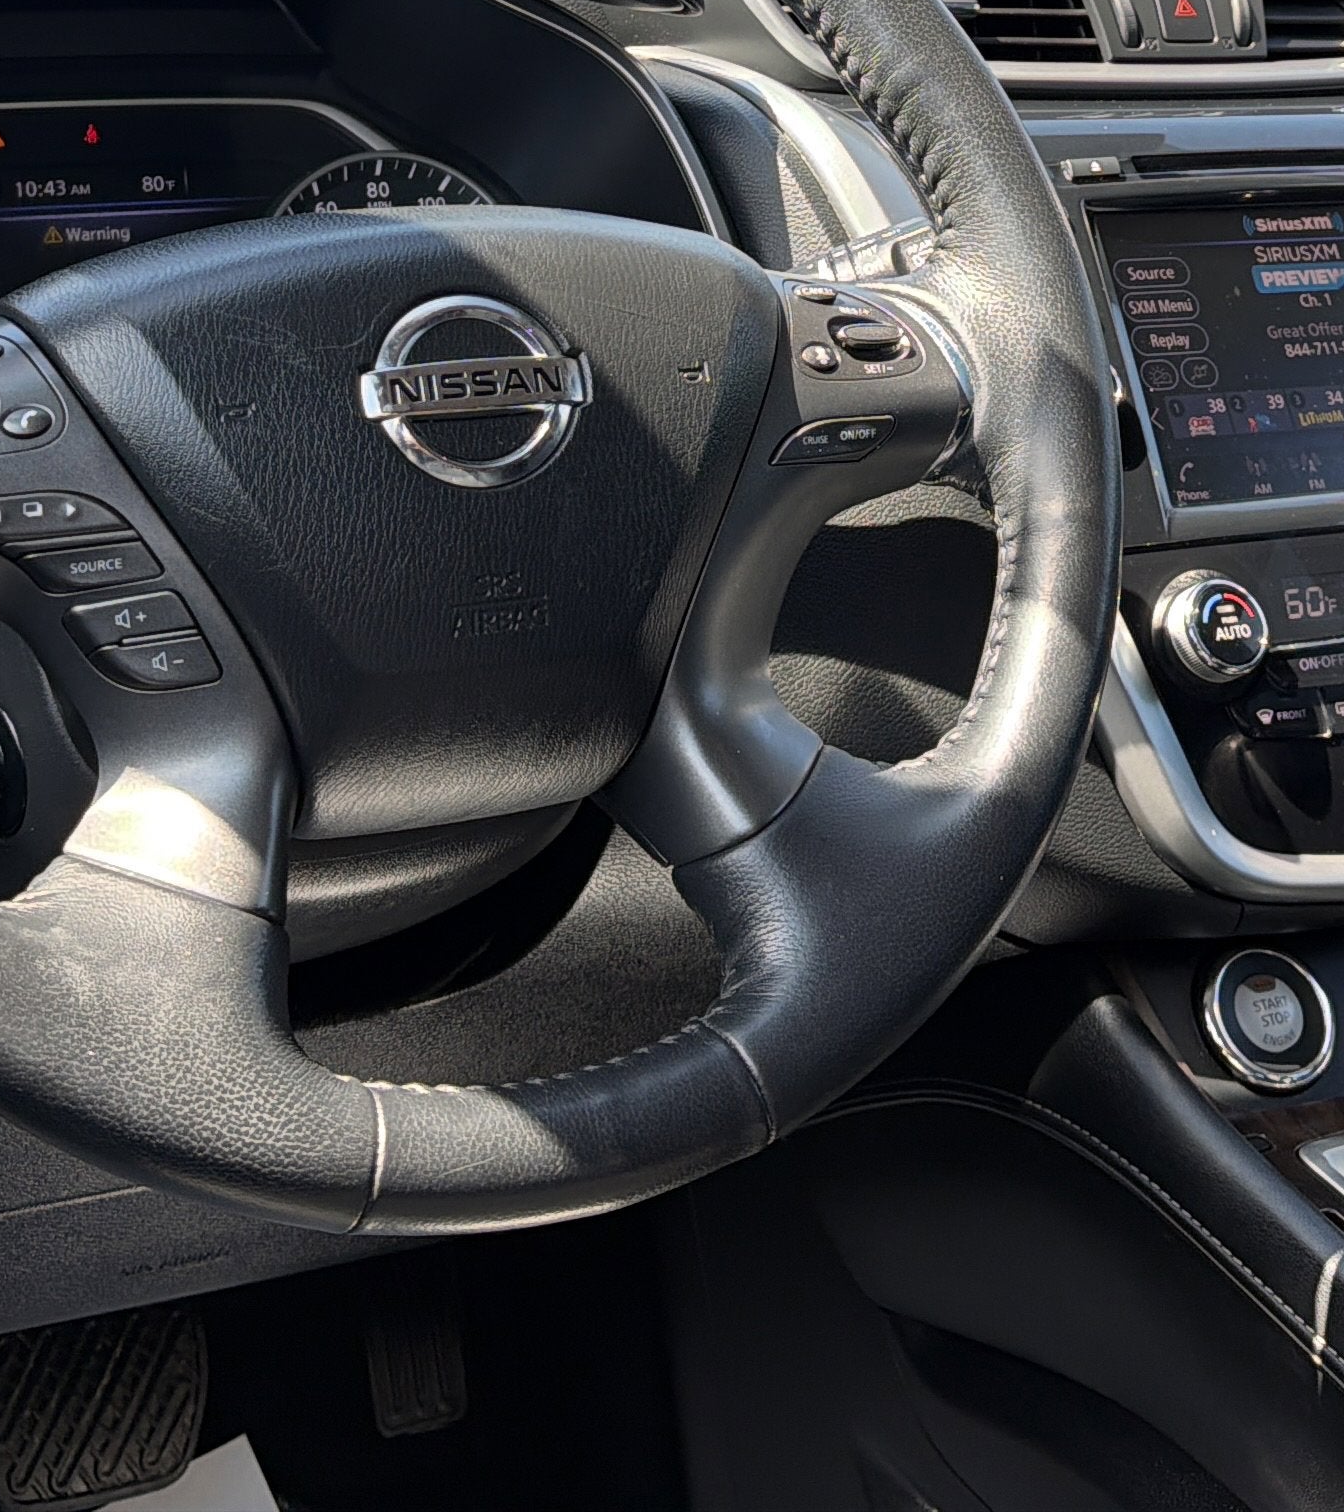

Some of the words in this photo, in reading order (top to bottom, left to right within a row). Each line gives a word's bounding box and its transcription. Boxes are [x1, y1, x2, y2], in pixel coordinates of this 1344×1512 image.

[15, 180, 67, 198] 10:43
[70, 184, 91, 196] AM
[367, 181, 390, 198] 80
[66, 227, 131, 244] Warning
[1254, 243, 1341, 263] SIRIUSXM
[1127, 265, 1176, 281] Source
[1261, 268, 1344, 287] PREVIEW
[1128, 299, 1156, 315] SXM
[1159, 297, 1193, 313] Menu
[1299, 293, 1322, 308] Ch.
[1325, 292, 1332, 306] 1
[1267, 323, 1305, 340] Great
[1310, 321, 1344, 338] Offer
[1149, 332, 1191, 350] Replay
[390, 365, 565, 405] NISSAN
[1207, 398, 1227, 414] 38
[1234, 399, 1242, 410] 2
[1266, 394, 1285, 410] 39
[1325, 391, 1344, 406] 34
[802, 435, 829, 446] CRUISE
[840, 427, 877, 443] ON/OFF
[1254, 483, 1273, 495] AM
[1308, 479, 1326, 491] FM
[1177, 489, 1210, 501] Phone
[69, 557, 124, 575] SOURCE
[1215, 624, 1252, 642] AUTO
[1276, 708, 1306, 721] FRONT
[1253, 995, 1288, 1013] START
[1261, 1011, 1291, 1028] STOP
